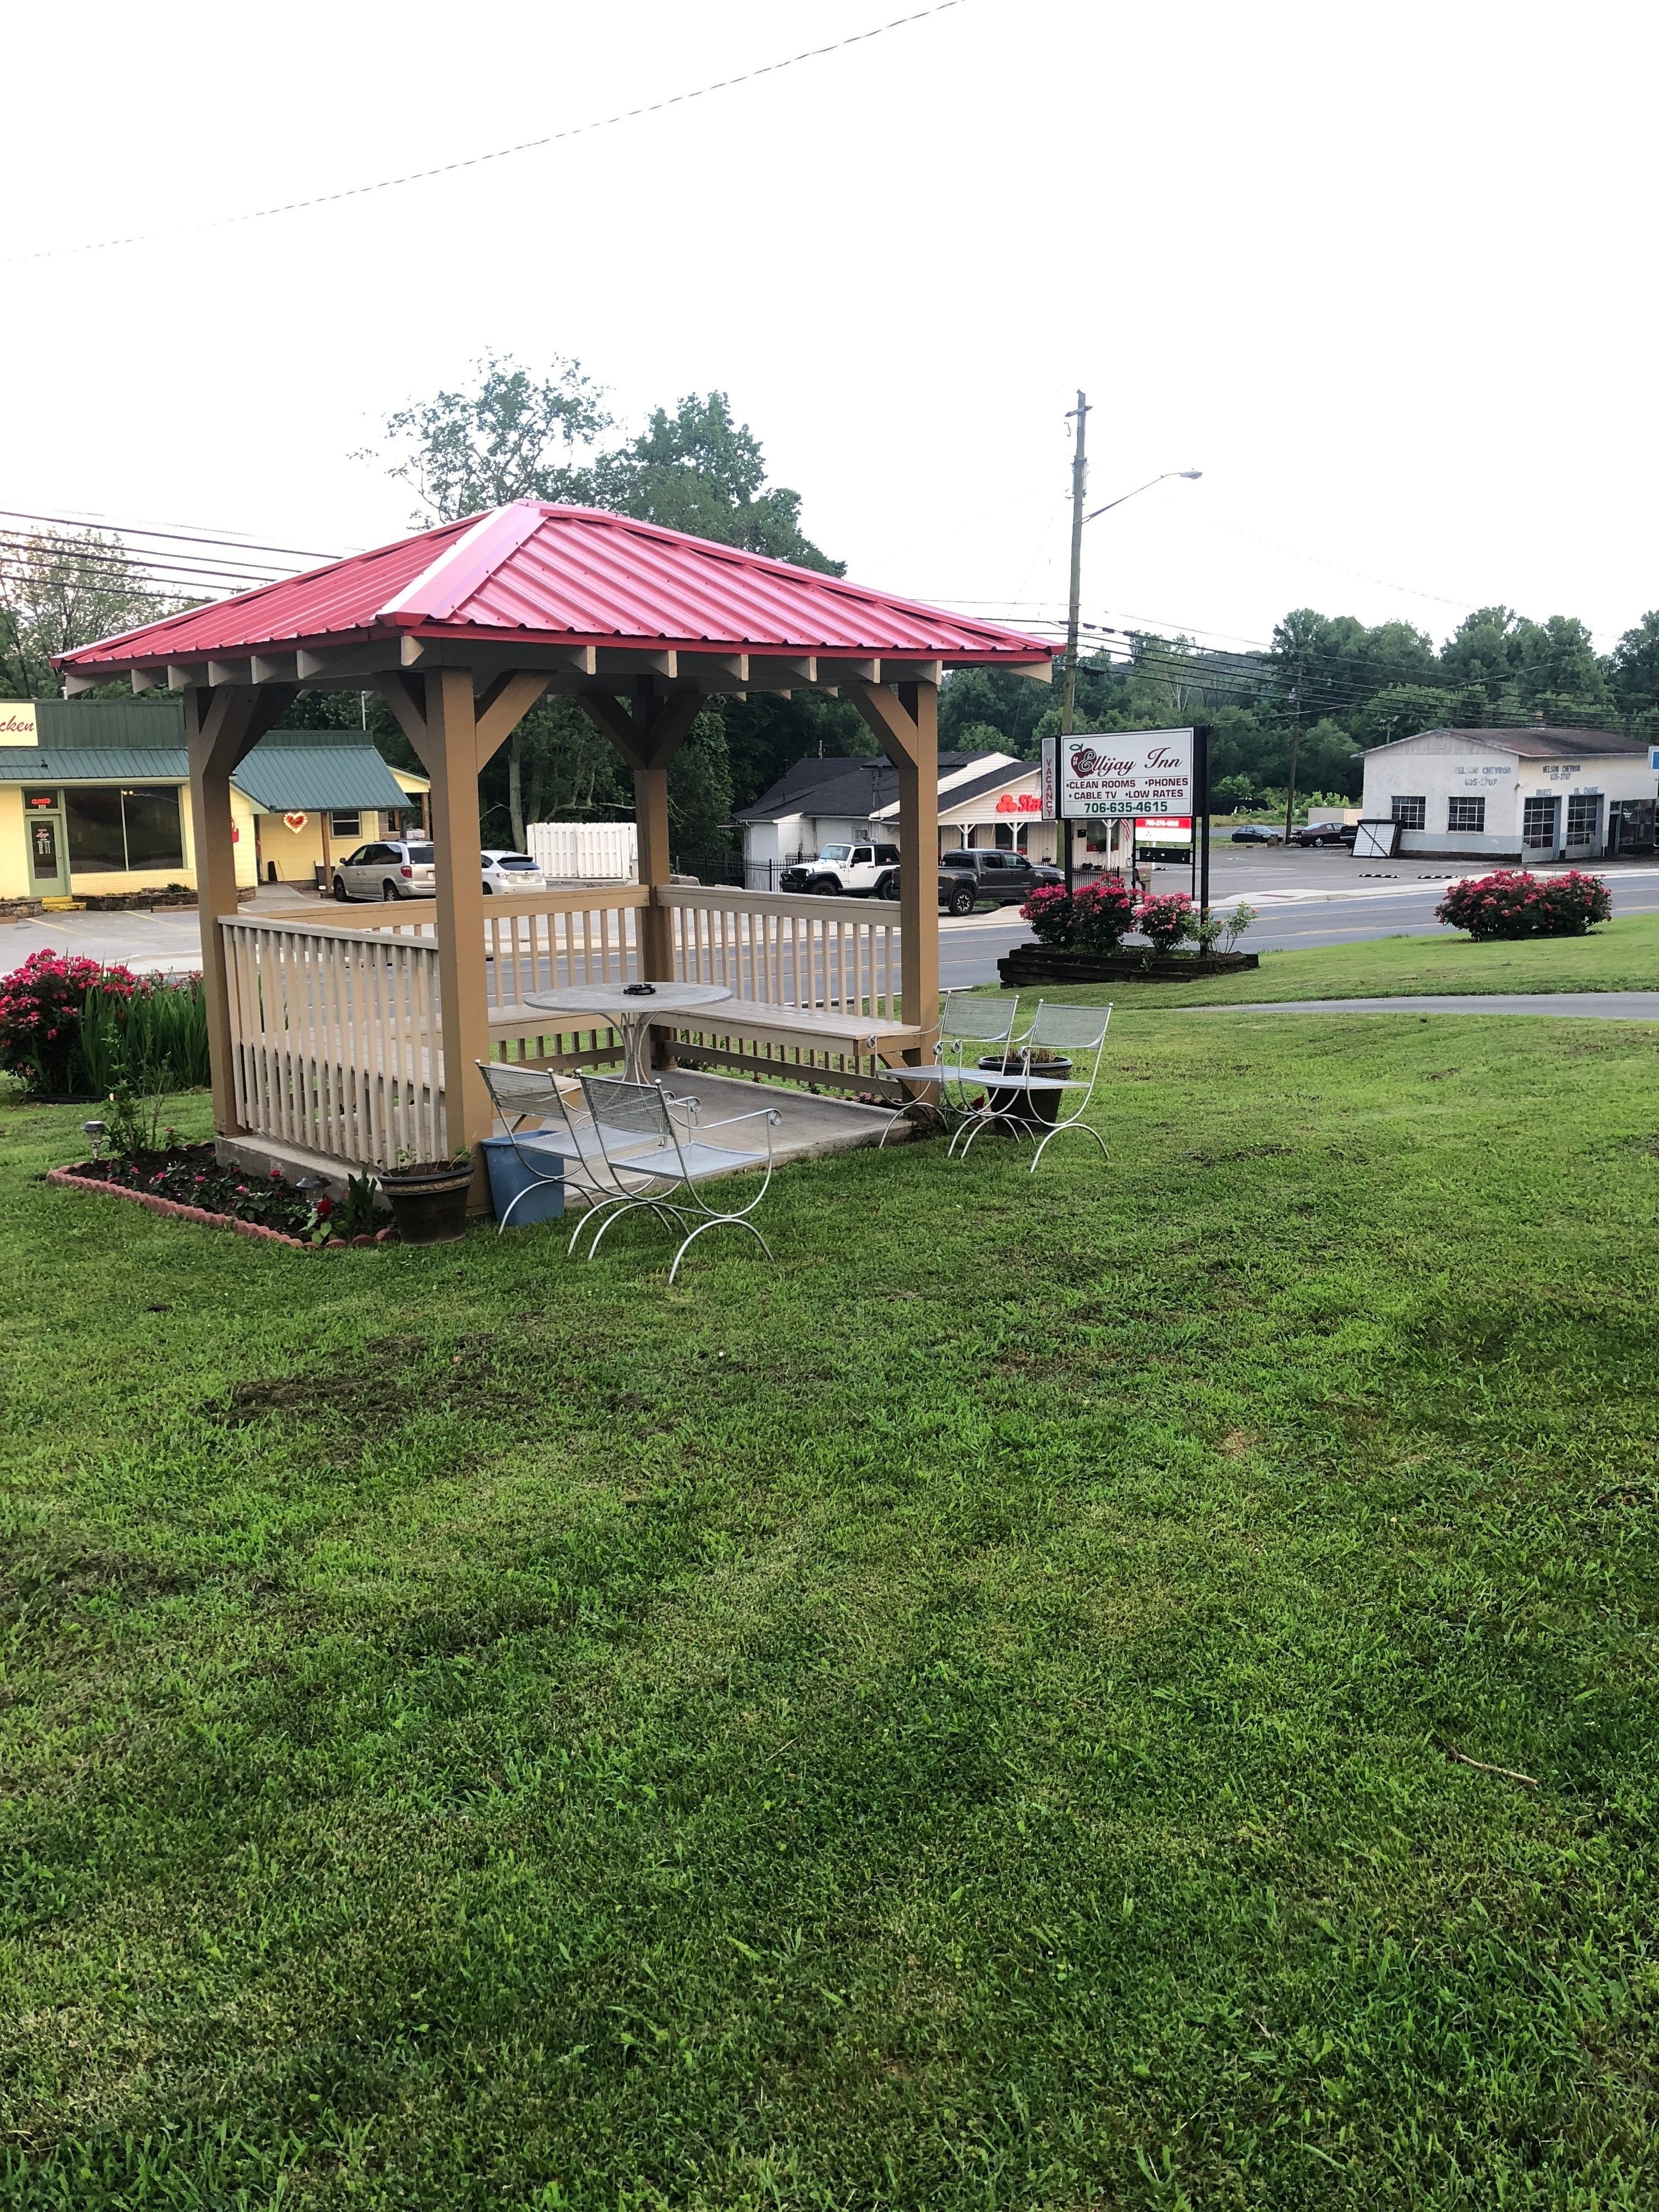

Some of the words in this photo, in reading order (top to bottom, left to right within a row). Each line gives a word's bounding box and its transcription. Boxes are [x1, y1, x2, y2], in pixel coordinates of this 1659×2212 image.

[1078, 751, 1137, 777] Ellijay
[1144, 747, 1183, 768] Inn
[1482, 766, 1511, 774] CHEVRON
[1069, 781, 1099, 789] CLEAN
[1101, 779, 1136, 789] ROOMS
[1148, 778, 1188, 787] PHONES
[1074, 791, 1102, 800] CABLE
[1105, 791, 1117, 799] TV
[1128, 790, 1149, 798] LOW
[1153, 789, 1183, 798] RATES
[1084, 801, 1168, 813] 706-635-4615
